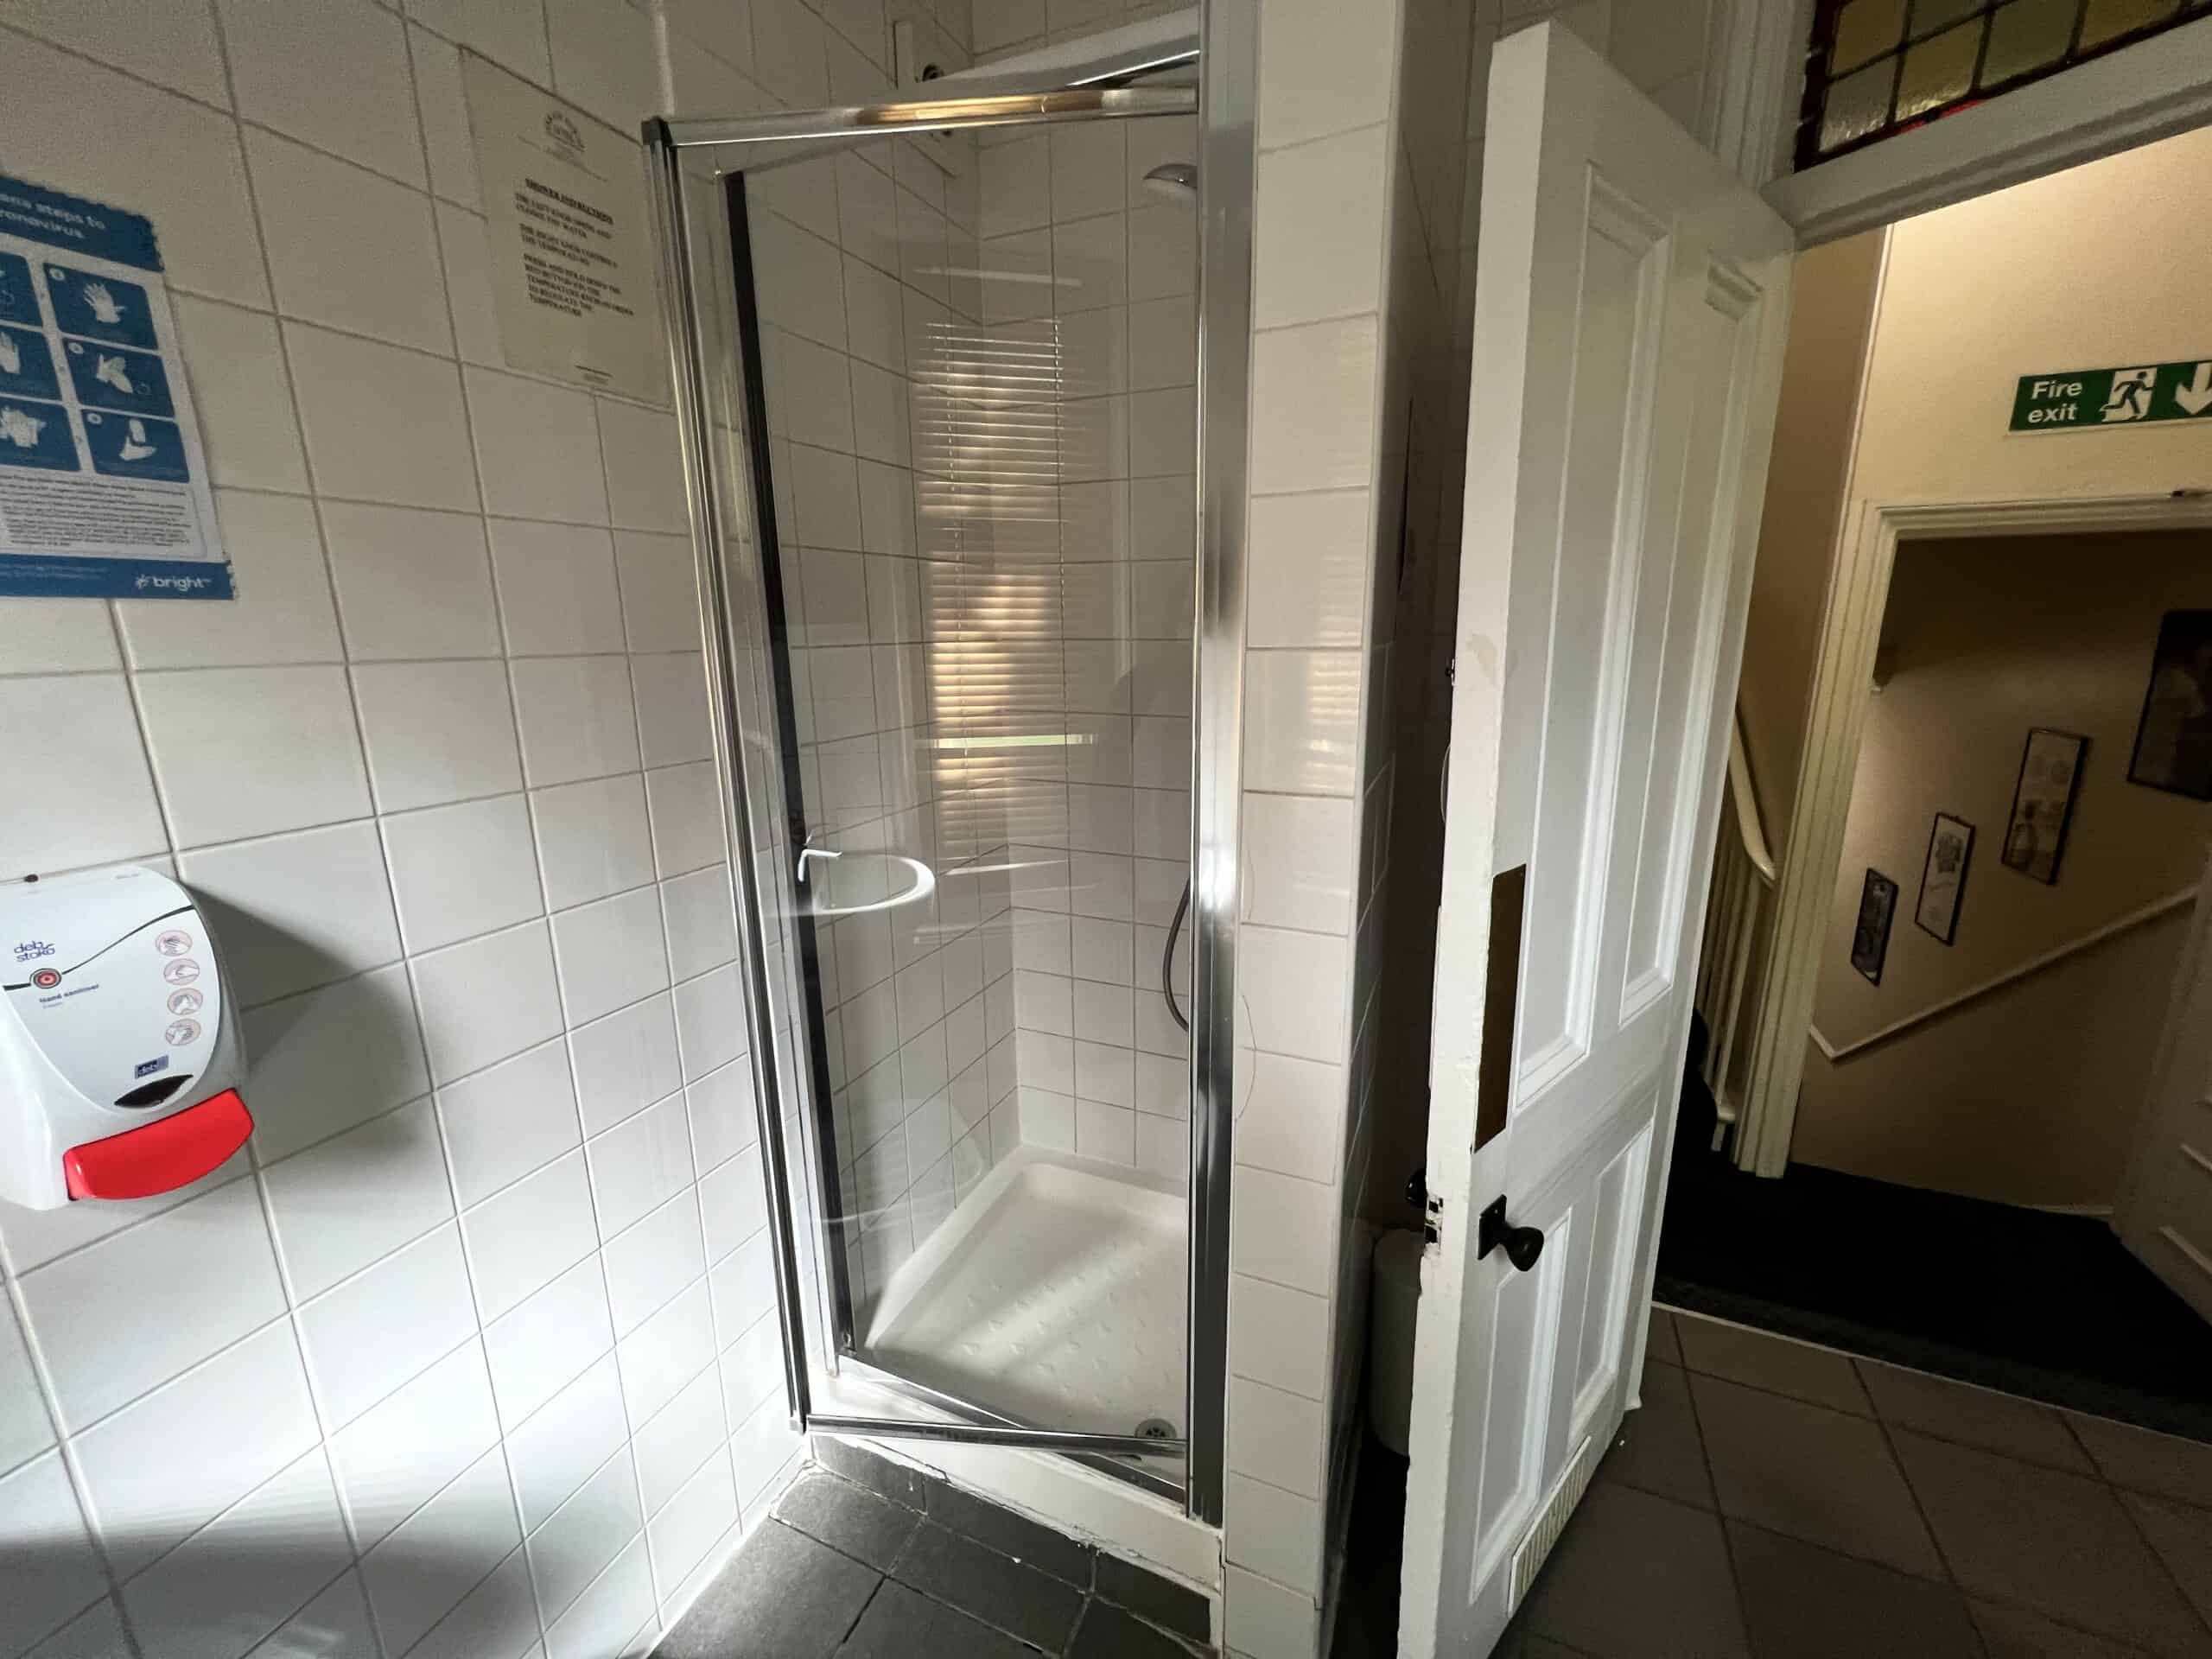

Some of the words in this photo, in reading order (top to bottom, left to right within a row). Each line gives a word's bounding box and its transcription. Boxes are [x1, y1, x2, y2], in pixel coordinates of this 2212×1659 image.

[86, 215, 105, 229] to
[2031, 380, 2082, 399] Fire
[2028, 403, 2078, 423] exit
[152, 575, 206, 593] bright
[14, 940, 43, 954] deb
